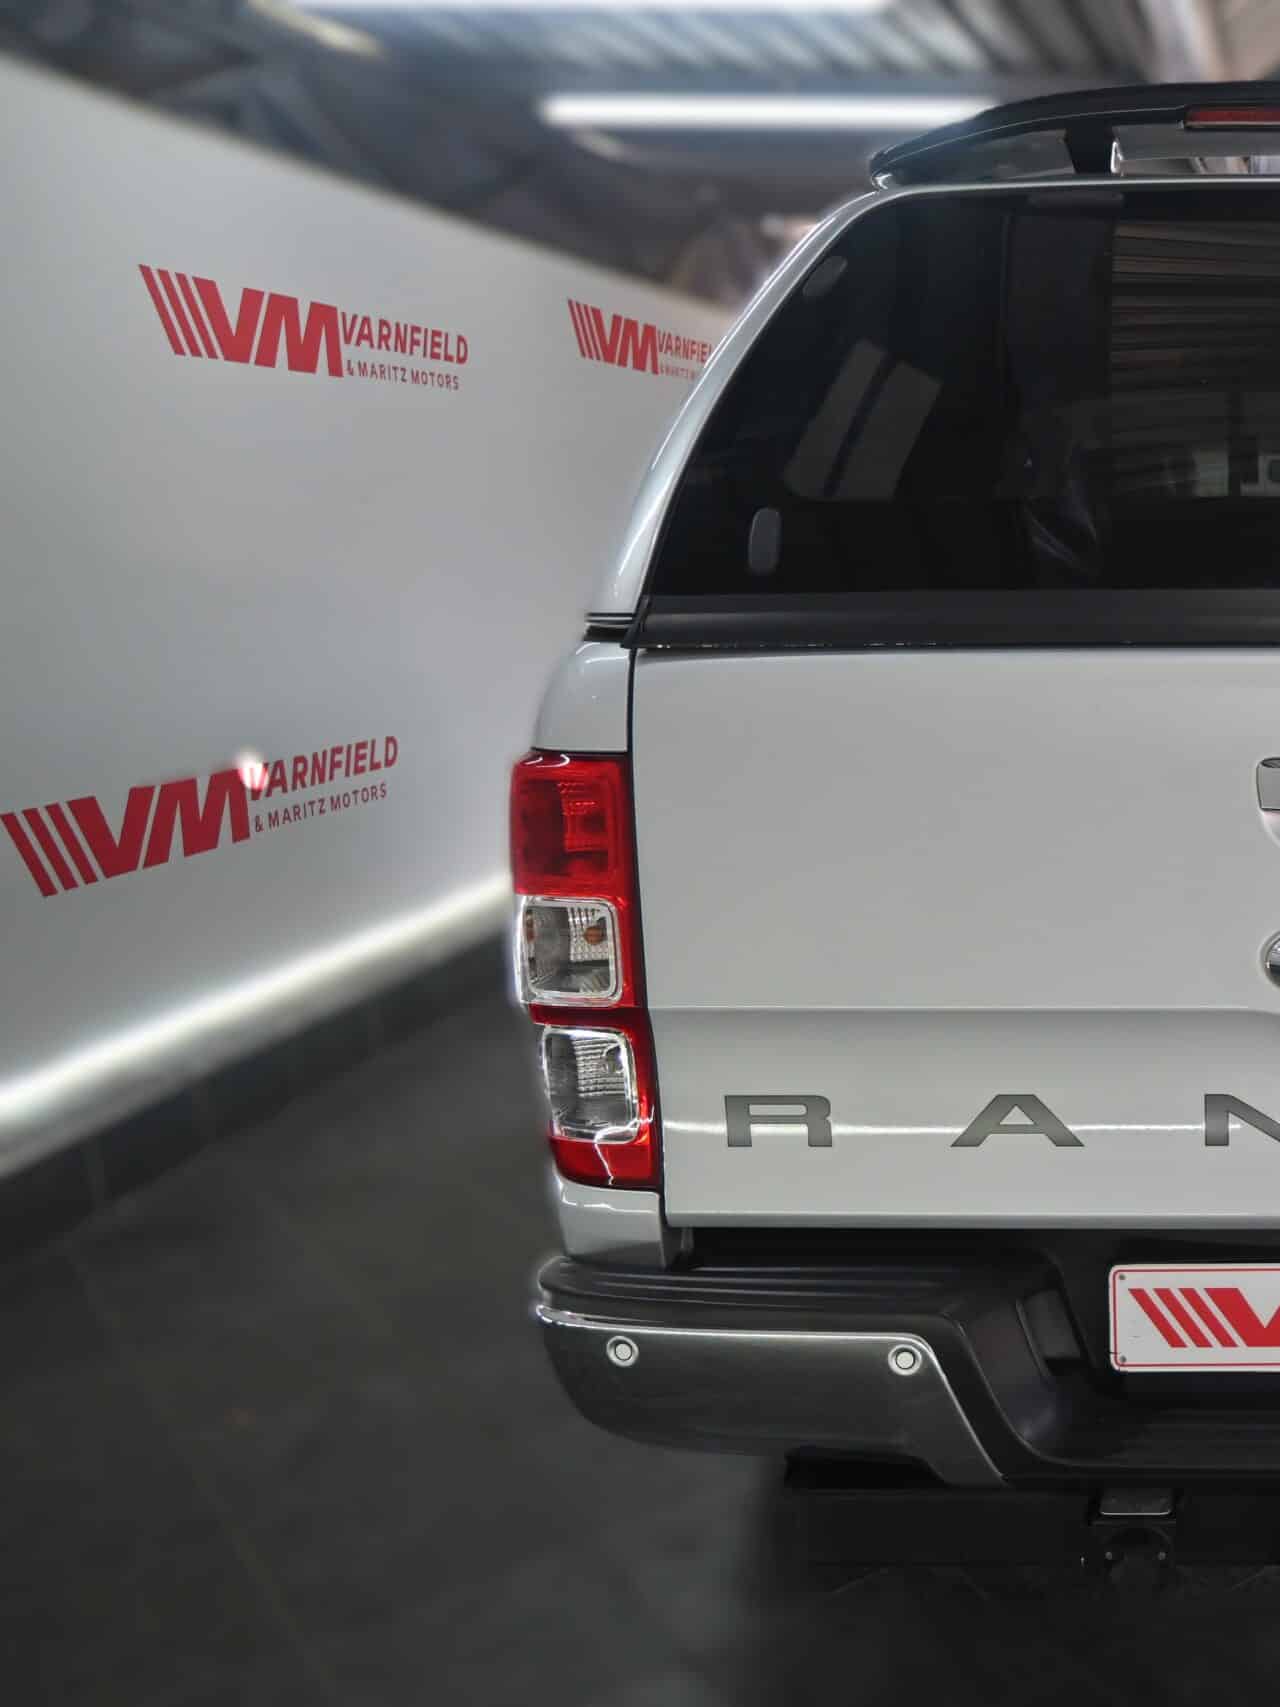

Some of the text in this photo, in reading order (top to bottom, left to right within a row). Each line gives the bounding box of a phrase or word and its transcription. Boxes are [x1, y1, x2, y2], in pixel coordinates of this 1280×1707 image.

[341, 311, 468, 364] VARNFIELD
[357, 360, 407, 382] MARITZ
[411, 367, 460, 390] MOTORS
[247, 736, 398, 800] VARNFIELD
[254, 783, 387, 832] & MARITZ MOTORS
